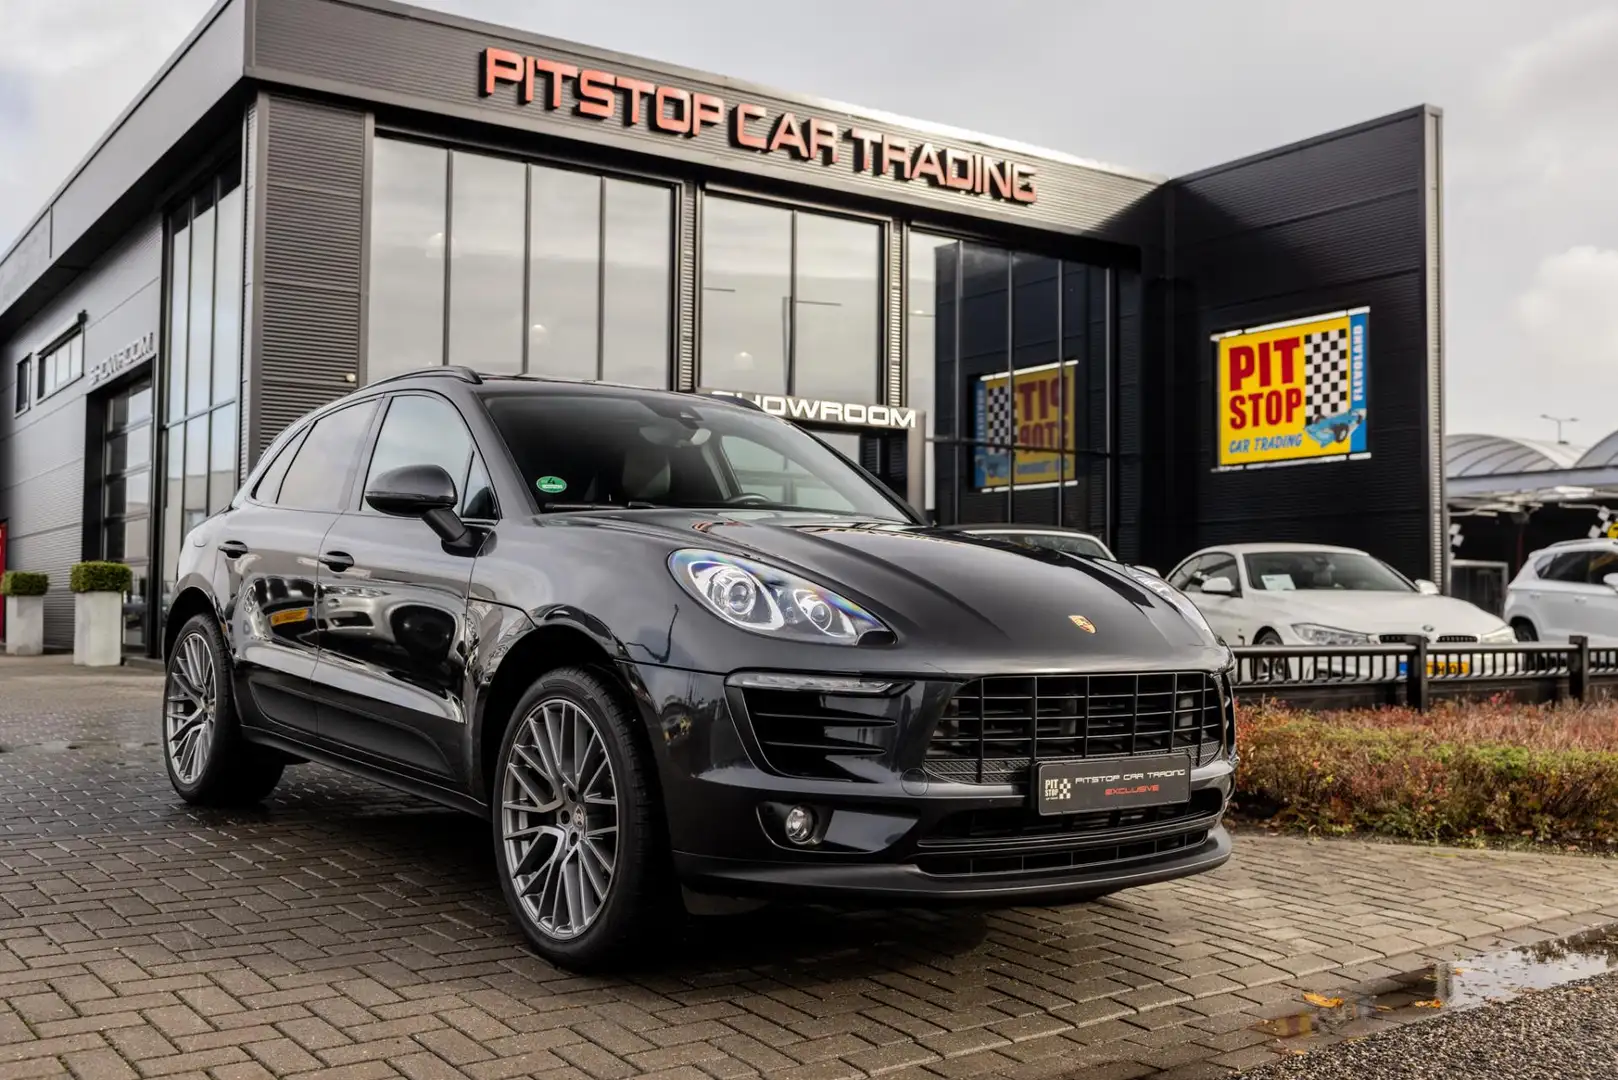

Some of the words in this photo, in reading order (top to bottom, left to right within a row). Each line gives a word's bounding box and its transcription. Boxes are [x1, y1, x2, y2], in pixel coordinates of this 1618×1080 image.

[480, 46, 725, 137] PITSTOP
[733, 103, 840, 165] CAR
[845, 127, 1038, 204] TRADING
[1228, 336, 1301, 392] PIT
[711, 390, 916, 428] OWROOM
[1229, 388, 1302, 430] STOP
[1229, 438, 1250, 454] CAR
[1254, 433, 1302, 452] TRADING
[1045, 779, 1058, 790] PIT
[1075, 774, 1120, 784] PITSTOP
[1123, 772, 1144, 781] CAR
[1147, 769, 1185, 779] TRADING
[1045, 789, 1058, 797] STOP
[1105, 784, 1159, 796] EXCLUSIVE
